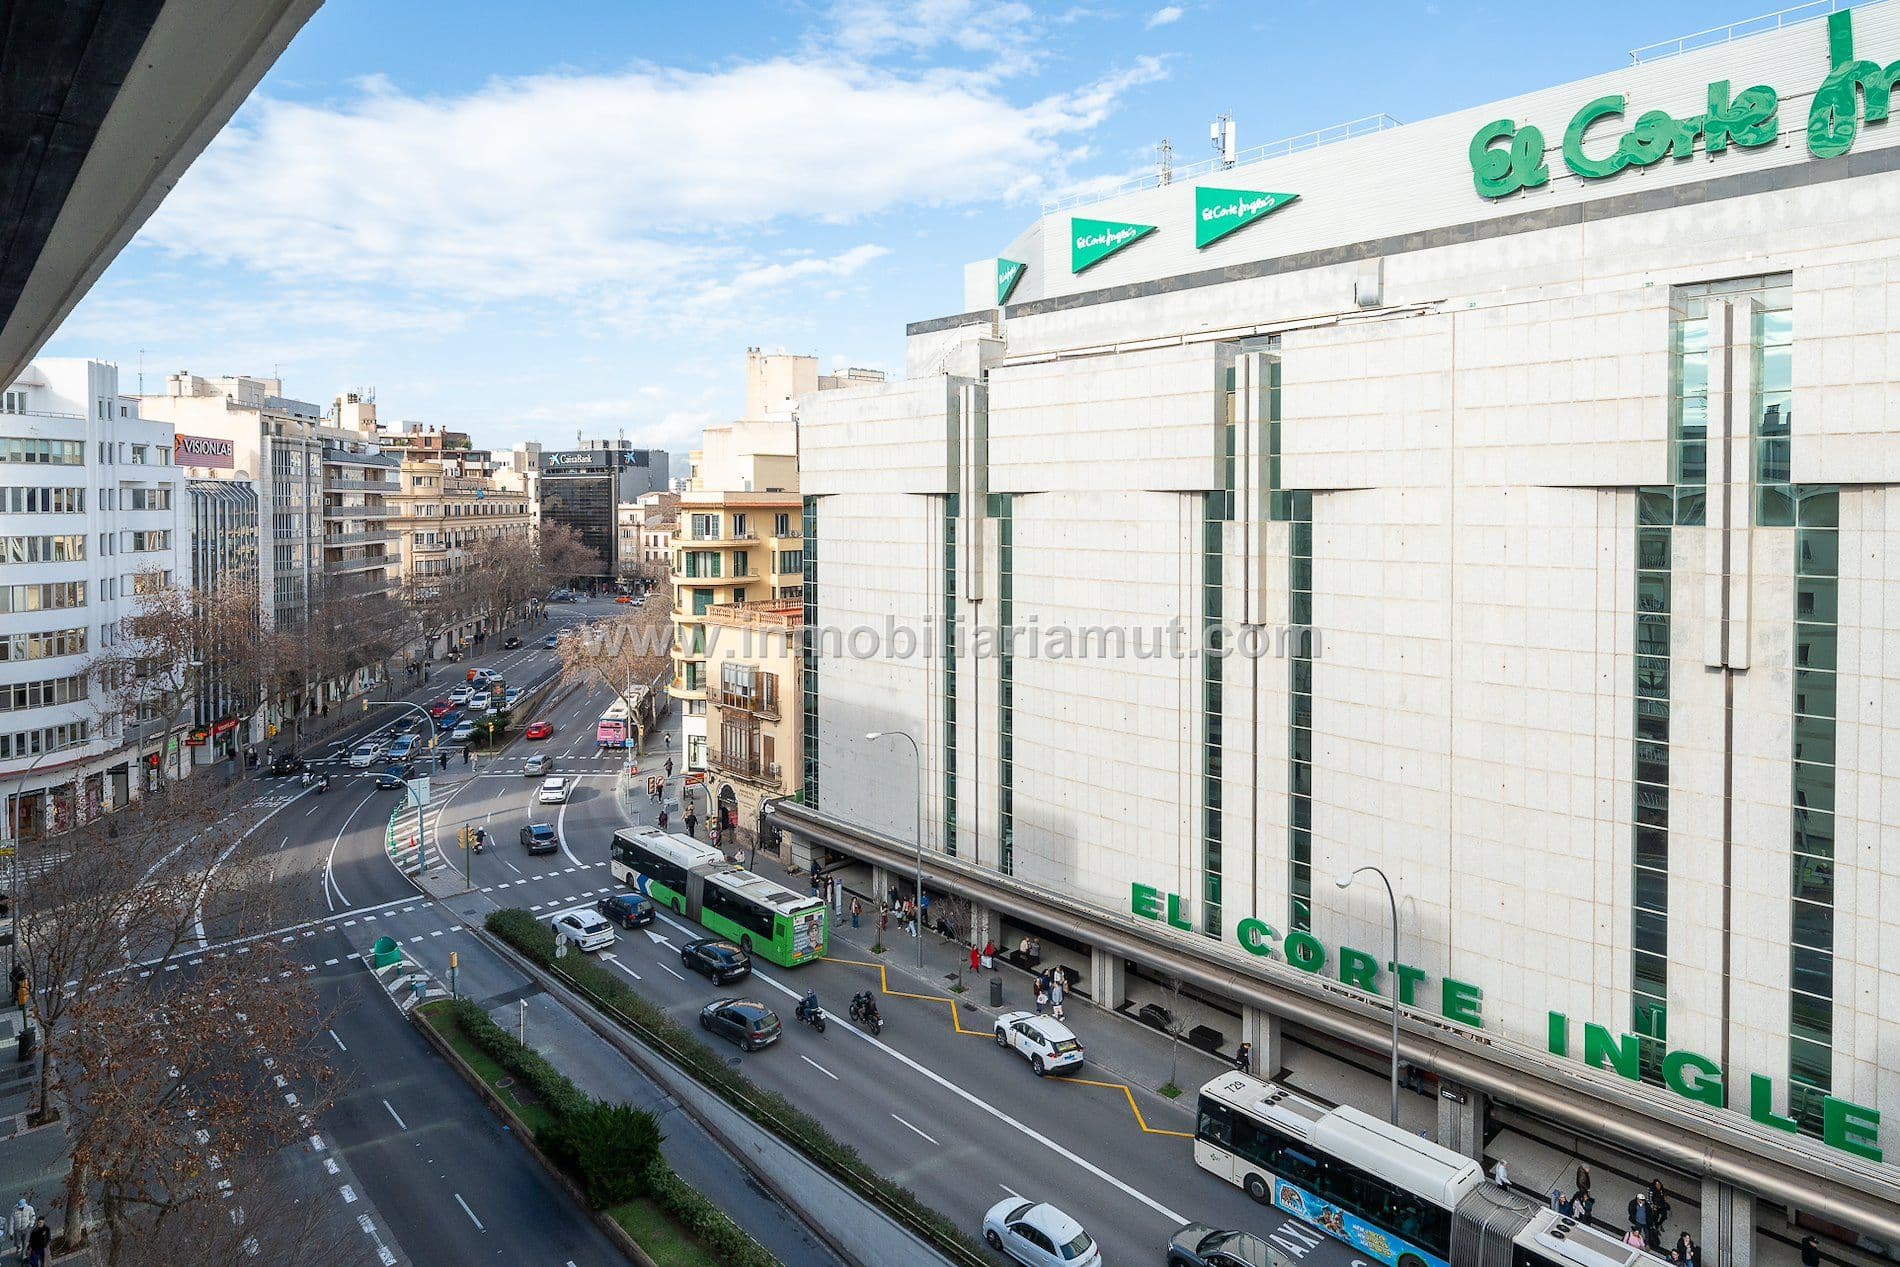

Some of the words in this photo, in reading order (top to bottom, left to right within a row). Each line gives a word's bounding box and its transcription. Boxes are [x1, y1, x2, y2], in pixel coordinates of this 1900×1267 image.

[1469, 119, 1549, 198] El
[1563, 80, 1778, 178] Corte
[1213, 205, 1238, 219] Corte
[183, 439, 232, 456] VISIONLAB
[1131, 882, 1193, 931] EL
[1237, 916, 1482, 1028] CORTE
[1548, 1010, 1883, 1163] INGLE
[1269, 1219, 1325, 1258] AXI
